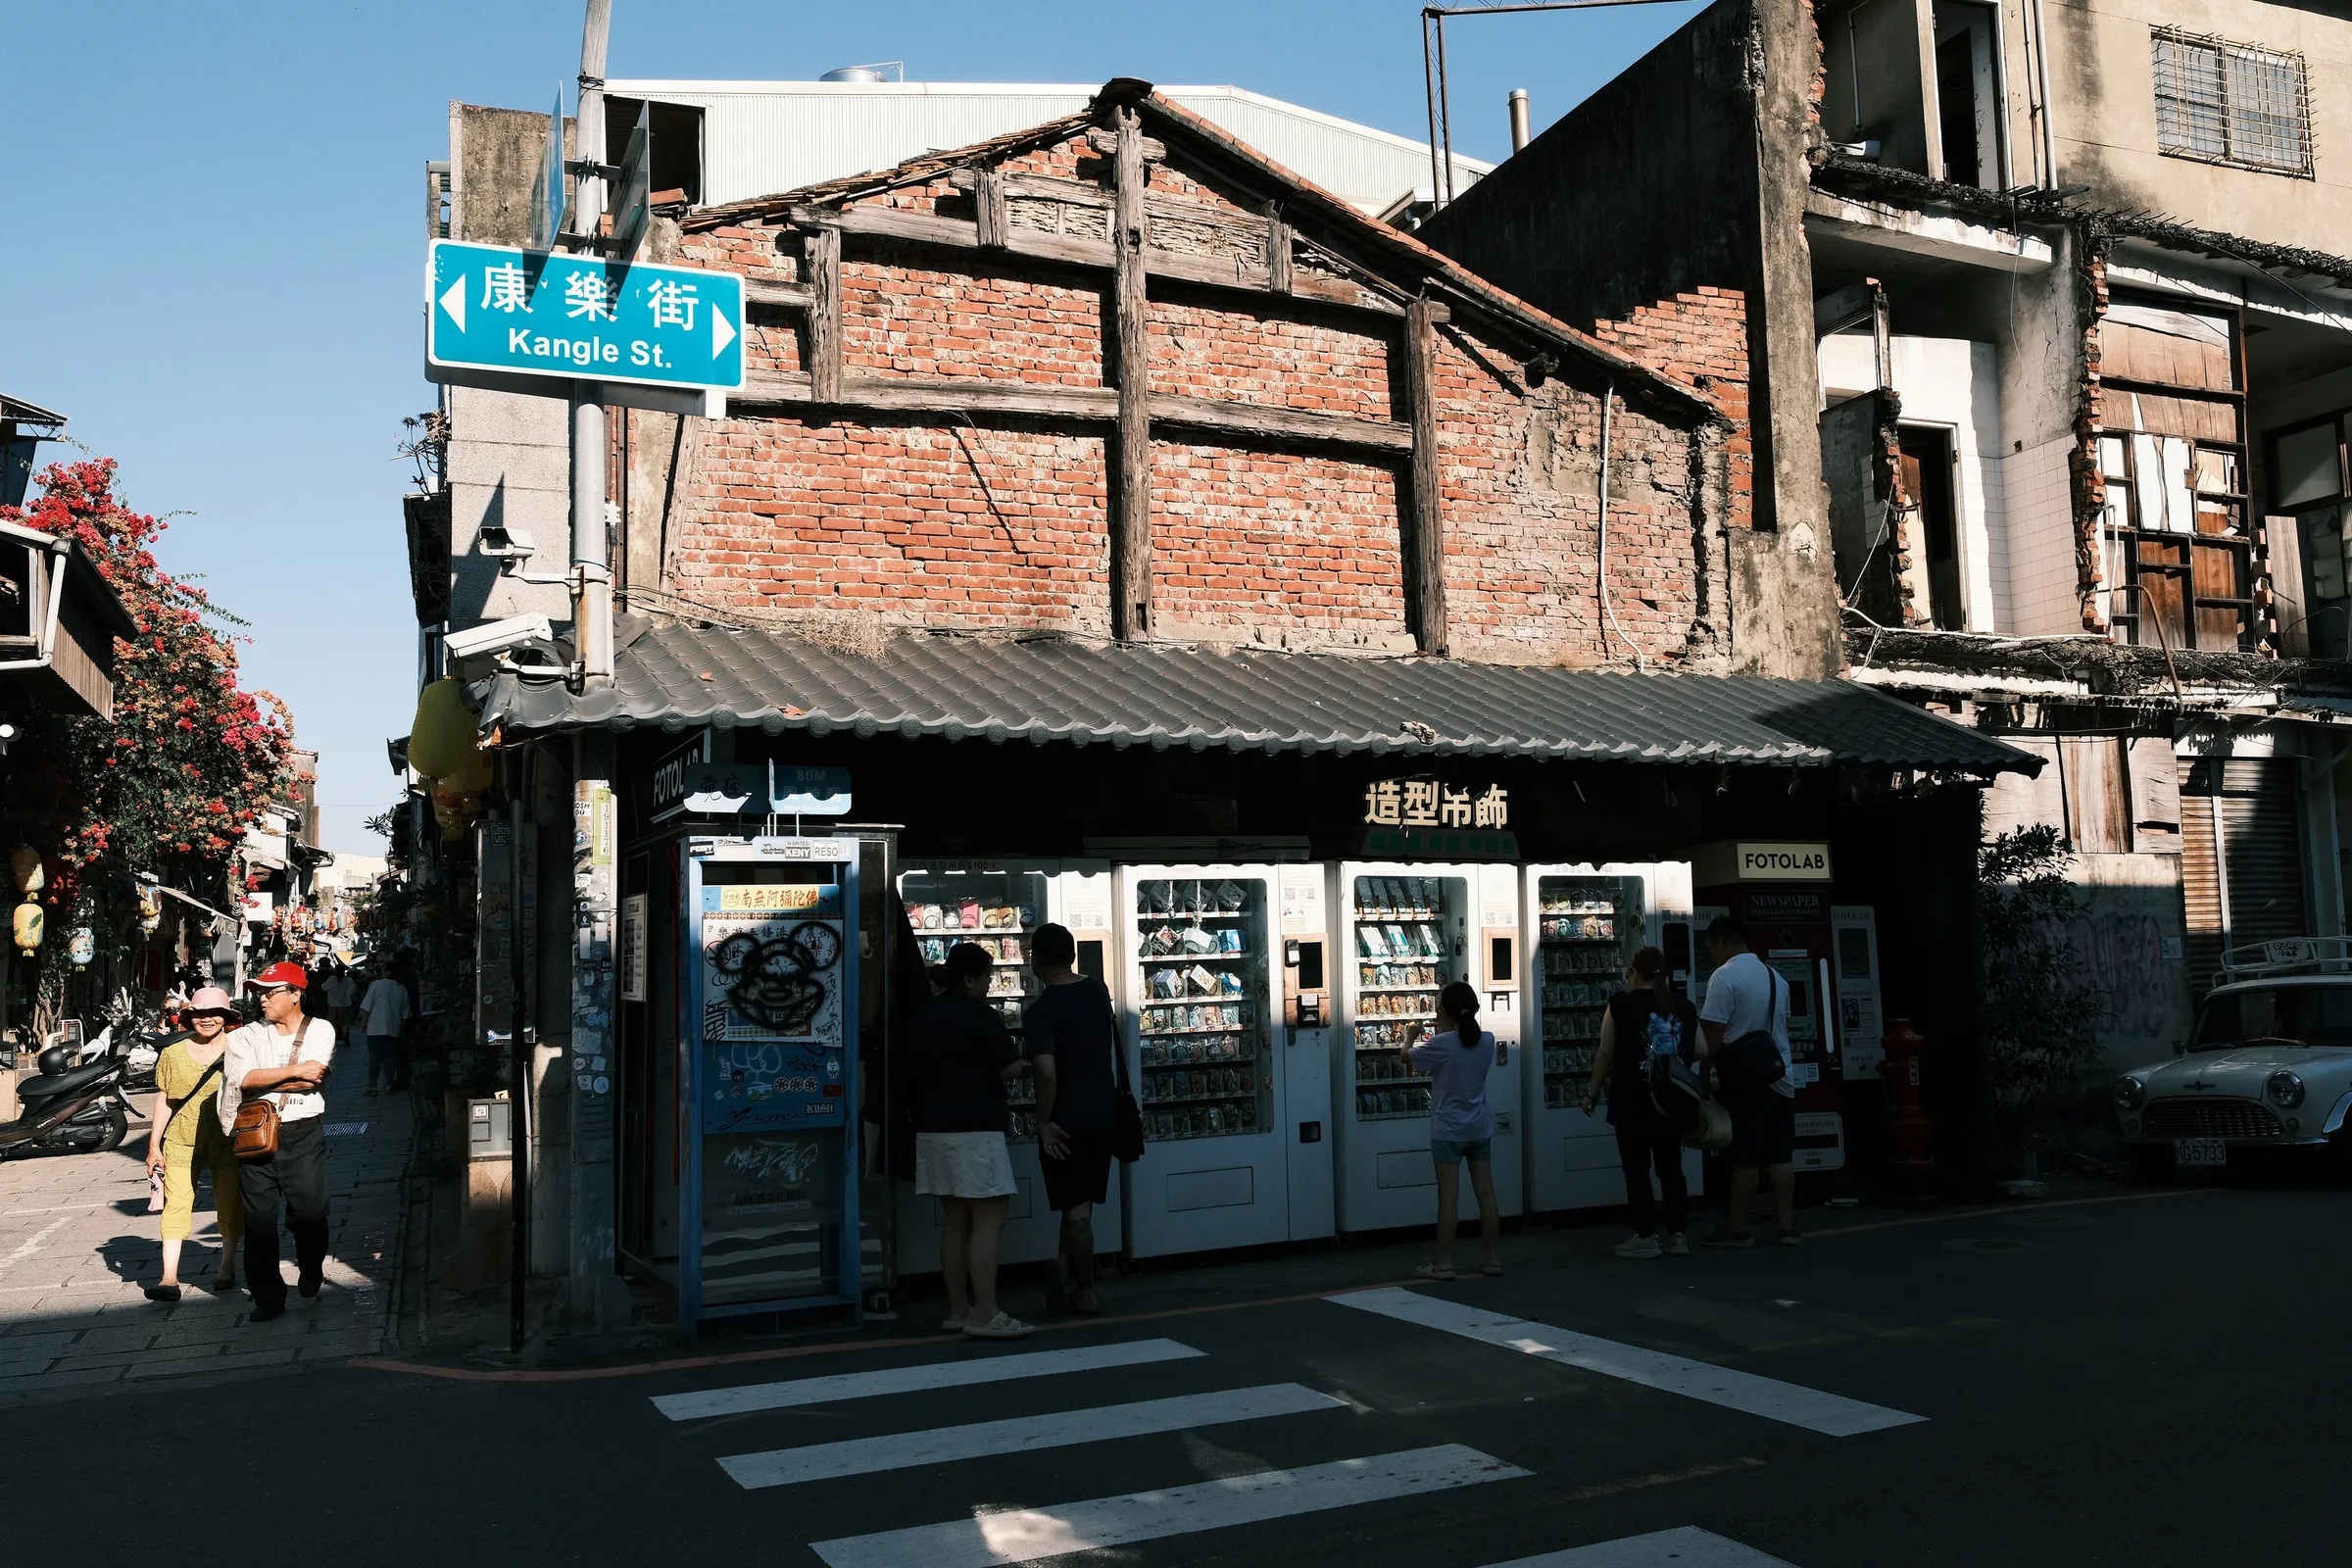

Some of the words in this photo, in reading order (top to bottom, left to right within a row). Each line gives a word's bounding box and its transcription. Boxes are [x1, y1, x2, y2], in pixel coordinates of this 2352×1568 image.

[480, 262, 699, 331] 康樂街
[509, 327, 619, 366] Kangle
[630, 339, 672, 368] St.
[653, 748, 699, 807] FOTOL
[796, 769, 826, 782] 80M
[783, 785, 842, 802] 風神廟
[1362, 780, 1509, 830] 造型吊飾
[786, 847, 811, 858] KENY
[814, 846, 838, 858] RESO
[1745, 854, 1825, 868] FOTOLAB
[741, 888, 818, 908] 南無阿彌陀佛
[1750, 895, 1820, 906] NEWSPAPER
[2175, 1144, 2225, 1162] MG-5733
